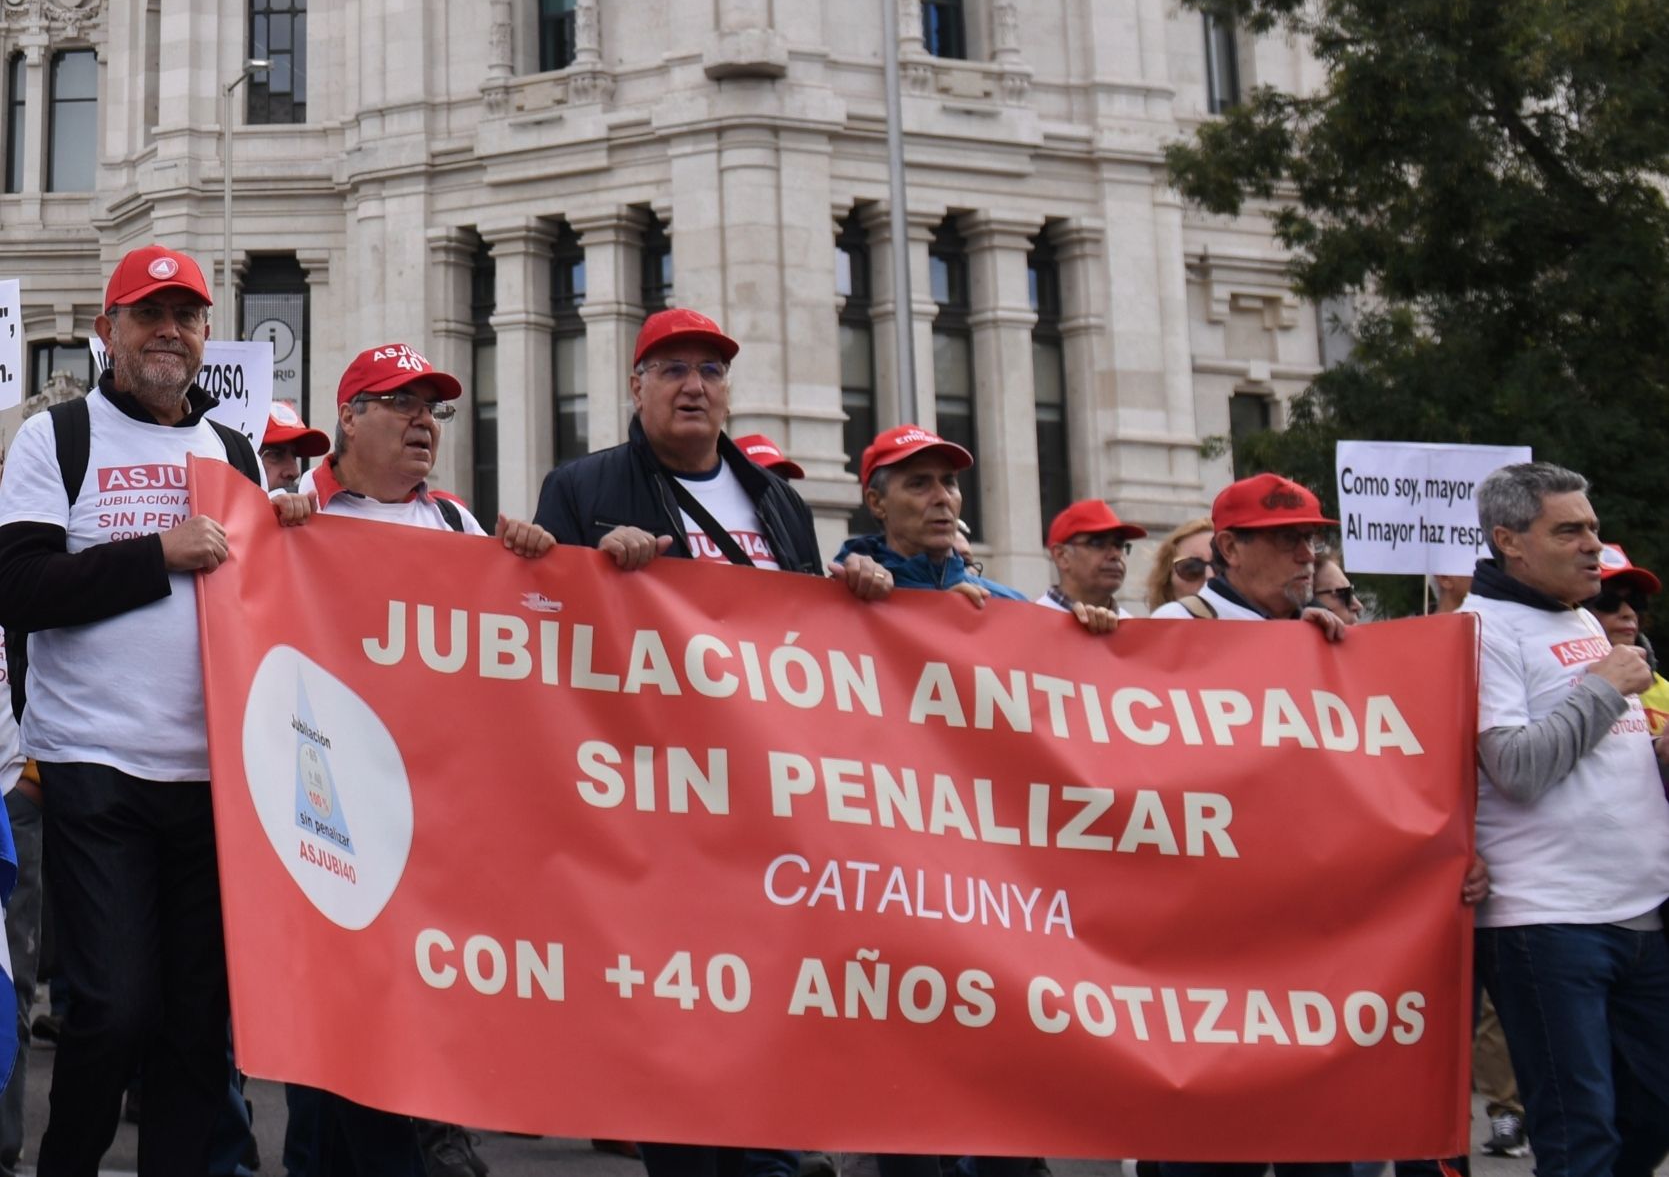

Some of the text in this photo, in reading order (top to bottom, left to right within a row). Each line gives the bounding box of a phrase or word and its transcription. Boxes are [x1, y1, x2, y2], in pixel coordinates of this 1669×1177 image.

[273, 368, 295, 382] RID
[397, 356, 423, 372] 40
[95, 493, 179, 508] JUBILACIÓN
[1340, 467, 1475, 508] Como soy, mayor
[98, 512, 135, 528] SIN
[1347, 513, 1362, 541] Al
[1368, 520, 1415, 550] mayor
[1419, 516, 1445, 543] haz
[363, 600, 1424, 757] JUBILACIÓN ANTICIPADA
[291, 714, 332, 750] Jubilación
[577, 739, 1239, 858] SIN PENALIZAR
[300, 811, 350, 848] sin penalizar
[300, 840, 356, 885] ASJUBI40
[763, 854, 1074, 939] CATALUNYA
[414, 927, 1425, 1047] CON +40 AÑOS COTIZADOS
